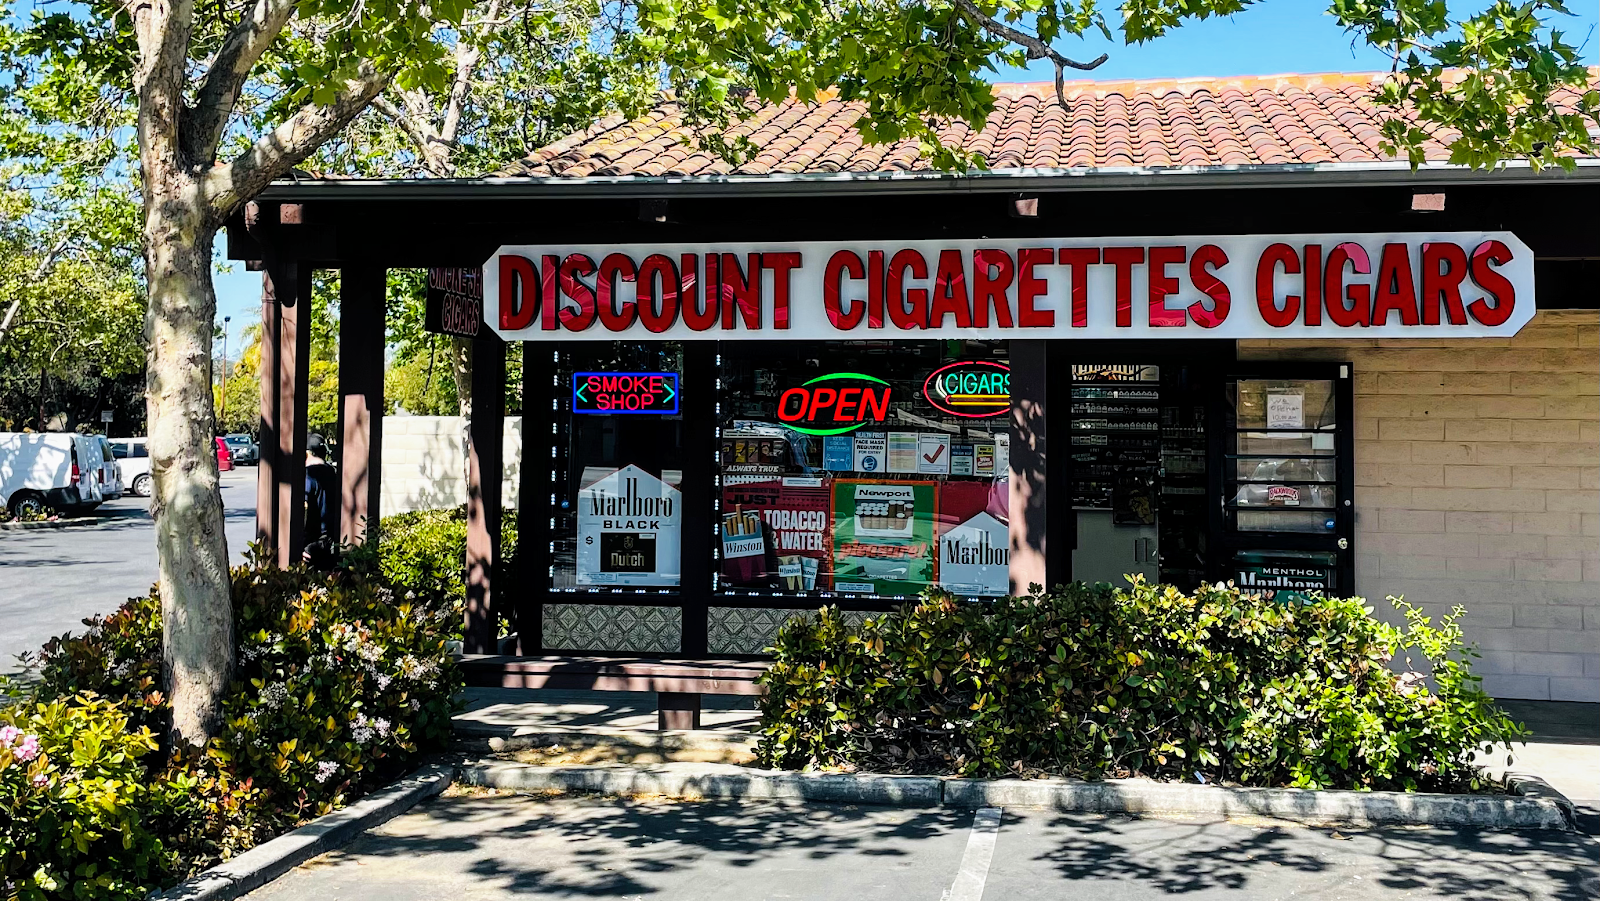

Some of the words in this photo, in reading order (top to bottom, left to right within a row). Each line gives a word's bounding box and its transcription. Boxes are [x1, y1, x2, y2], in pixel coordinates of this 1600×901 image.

[498, 252, 802, 332] DISCOUNT
[823, 244, 1231, 331] CIGARETTES
[1255, 240, 1516, 328] CIGARS
[442, 293, 480, 336] CIGARS
[587, 375, 664, 394] SMOKE
[596, 394, 655, 411] SHOP
[777, 387, 892, 422] OPEN
[758, 465, 780, 473] TRUE
[589, 477, 673, 518] Marlboro
[727, 494, 780, 505] JUST
[859, 489, 911, 498] Newport
[603, 520, 660, 530] BLACK
[763, 509, 826, 531] TOBACCO
[585, 535, 594, 546] $
[725, 541, 763, 555] Winston
[946, 530, 1010, 566] Marlbor
[611, 552, 645, 567] Dutch
[1262, 567, 1323, 577] MENTHOL
